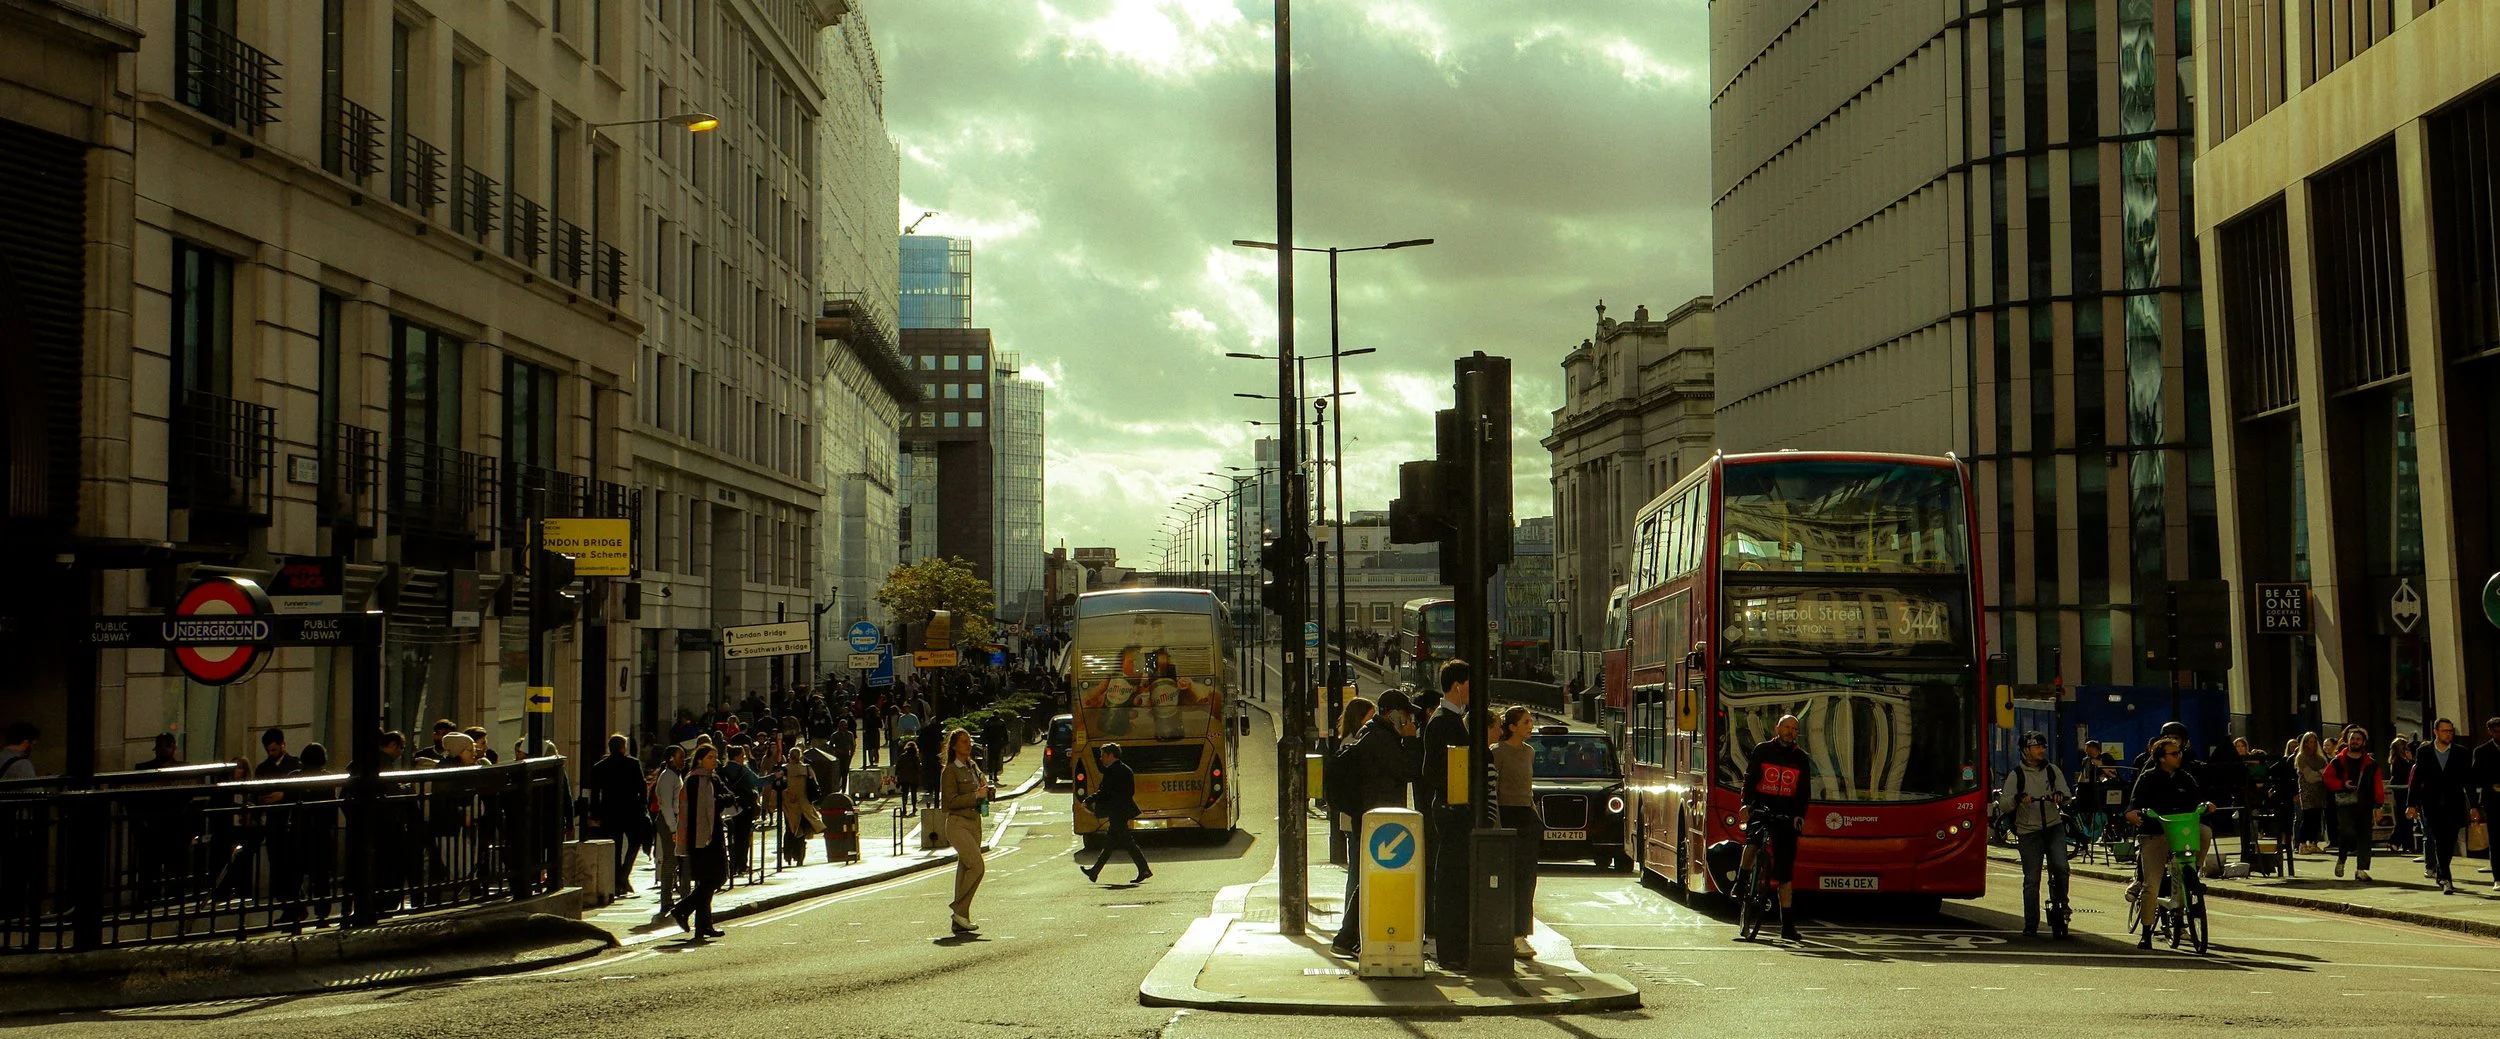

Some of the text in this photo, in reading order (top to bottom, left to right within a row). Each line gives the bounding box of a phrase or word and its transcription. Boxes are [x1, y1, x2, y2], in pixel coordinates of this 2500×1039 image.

[543, 538, 623, 547] ONDON BRIDGE
[590, 550, 628, 559] Scheme
[2266, 589, 2300, 598] BE AT
[2266, 598, 2301, 609] ONE
[1819, 606, 1862, 621] Street
[304, 619, 338, 629] PUBLIC
[1898, 606, 1939, 636] 344
[2266, 616, 2301, 627] BAR
[95, 622, 128, 632] PUBLIC
[161, 621, 269, 641] UNDERGROUND
[1785, 624, 1827, 633] STATION
[91, 632, 131, 643] SUBWAY
[300, 630, 342, 640] SUBWAY
[735, 629, 787, 639] London Bridge
[744, 643, 808, 655] Southwark Bridge
[1161, 780, 1202, 792] SEEKERS
[1957, 802, 1974, 810] 2473
[1823, 877, 1874, 888] SN64 OEX
